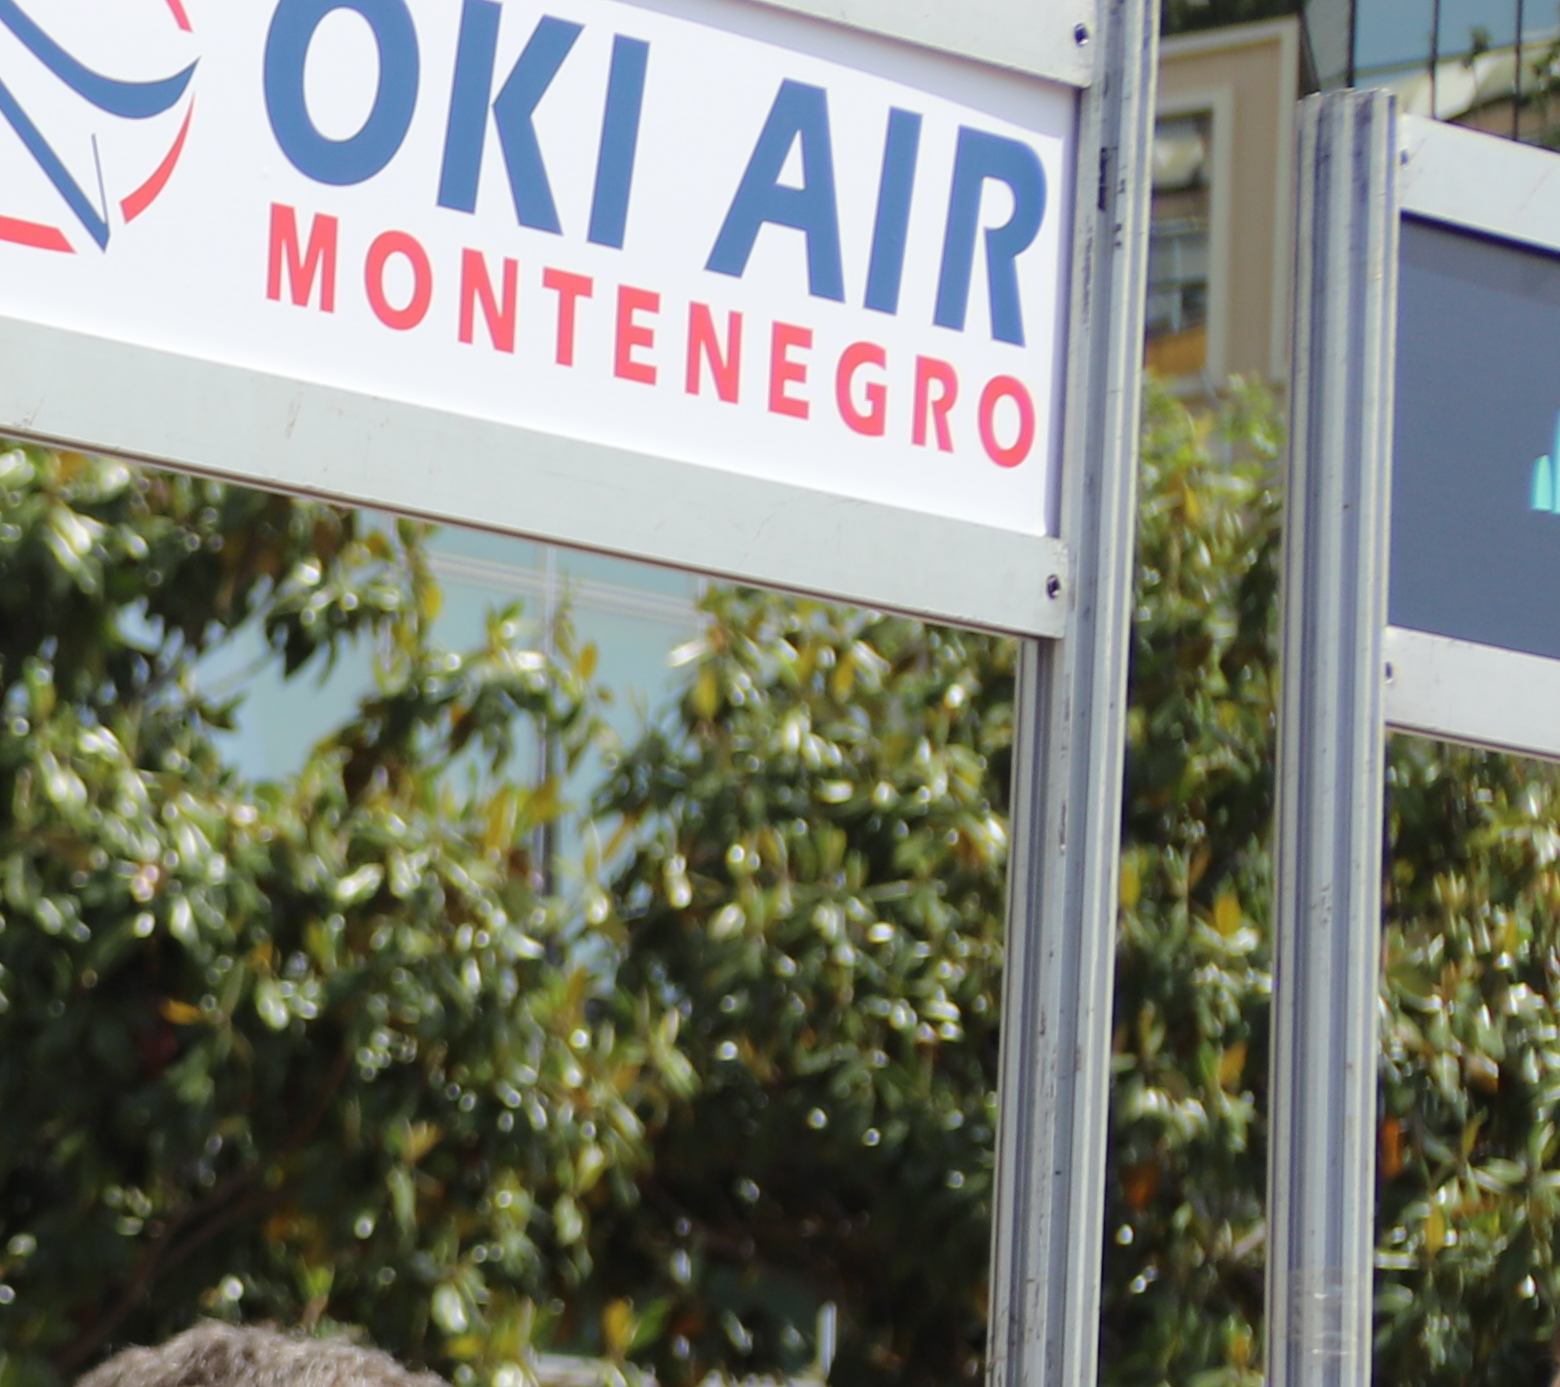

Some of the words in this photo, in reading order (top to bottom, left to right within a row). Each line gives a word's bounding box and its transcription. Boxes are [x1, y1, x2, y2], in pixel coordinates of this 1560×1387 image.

[262, 0, 650, 249] OKI
[704, 79, 1048, 348] AIR
[265, 202, 1036, 469] MONTENEGRO
